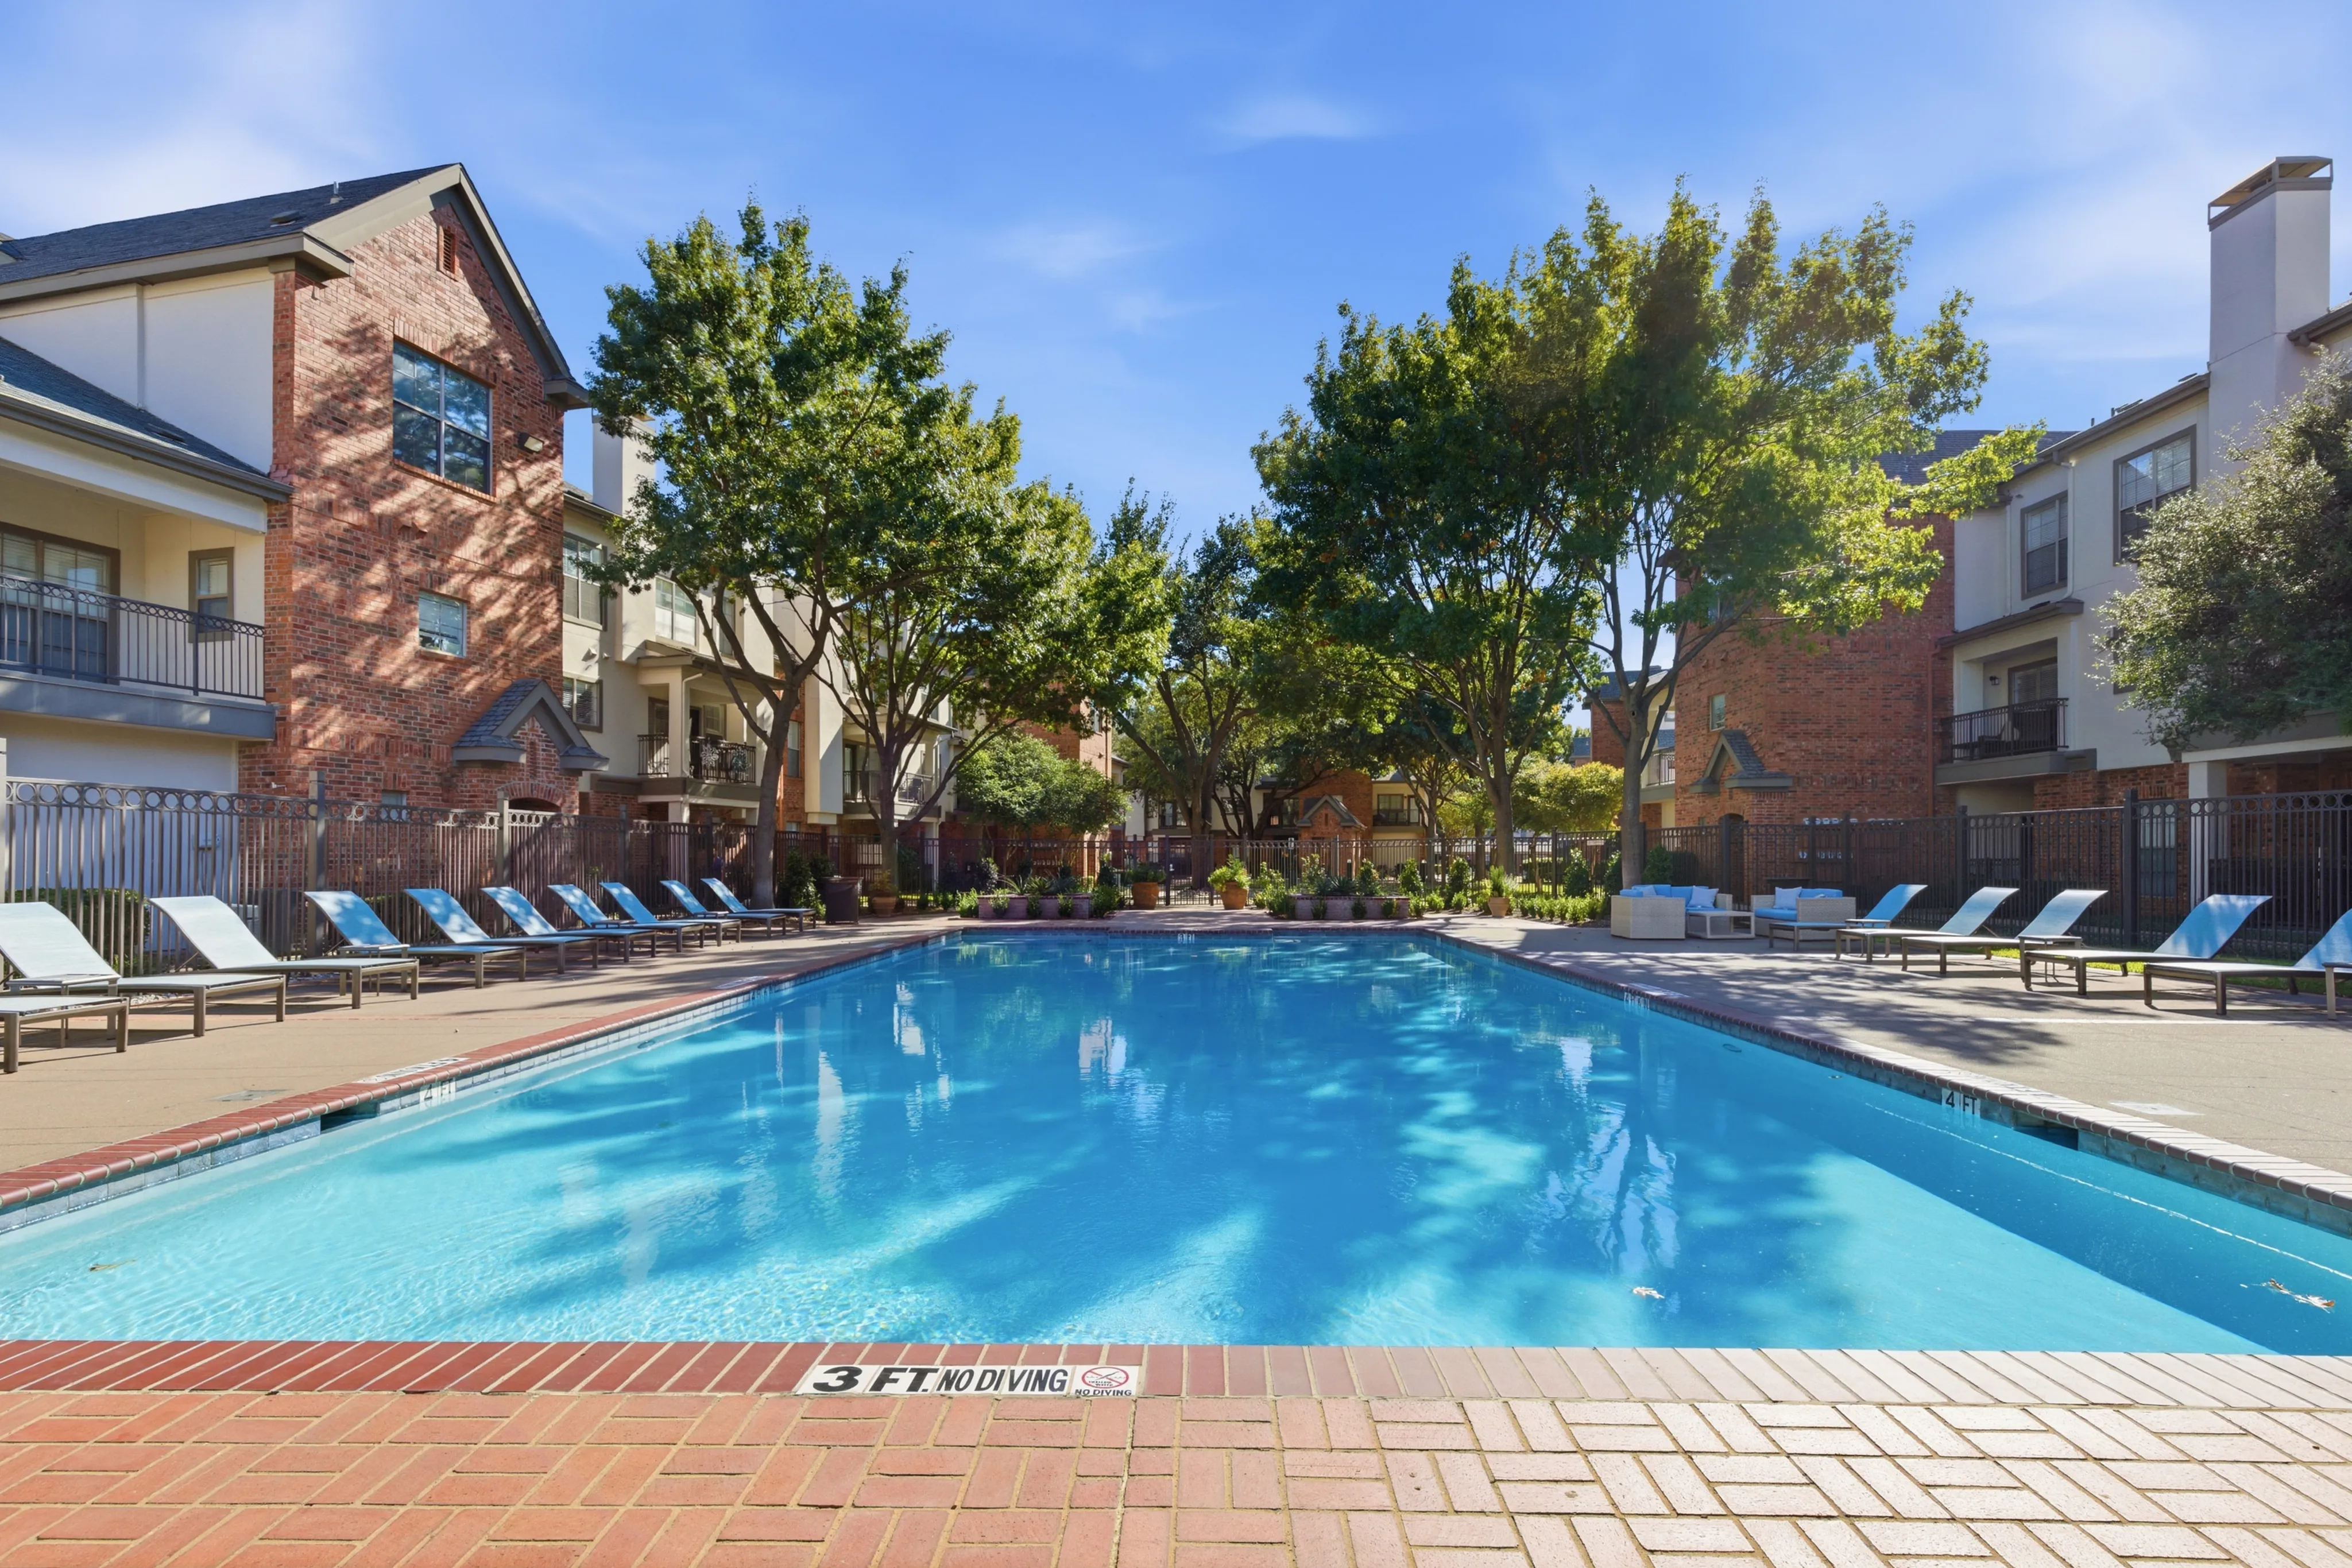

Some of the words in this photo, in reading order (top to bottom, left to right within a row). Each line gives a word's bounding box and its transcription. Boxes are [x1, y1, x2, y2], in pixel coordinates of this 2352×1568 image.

[1945, 1091, 1955, 1108] 4
[1963, 1094, 1977, 1114] FT
[813, 1366, 862, 1392] 3
[869, 1367, 940, 1392] FT.
[936, 1369, 975, 1391] NO
[974, 1369, 1068, 1392] DIVING
